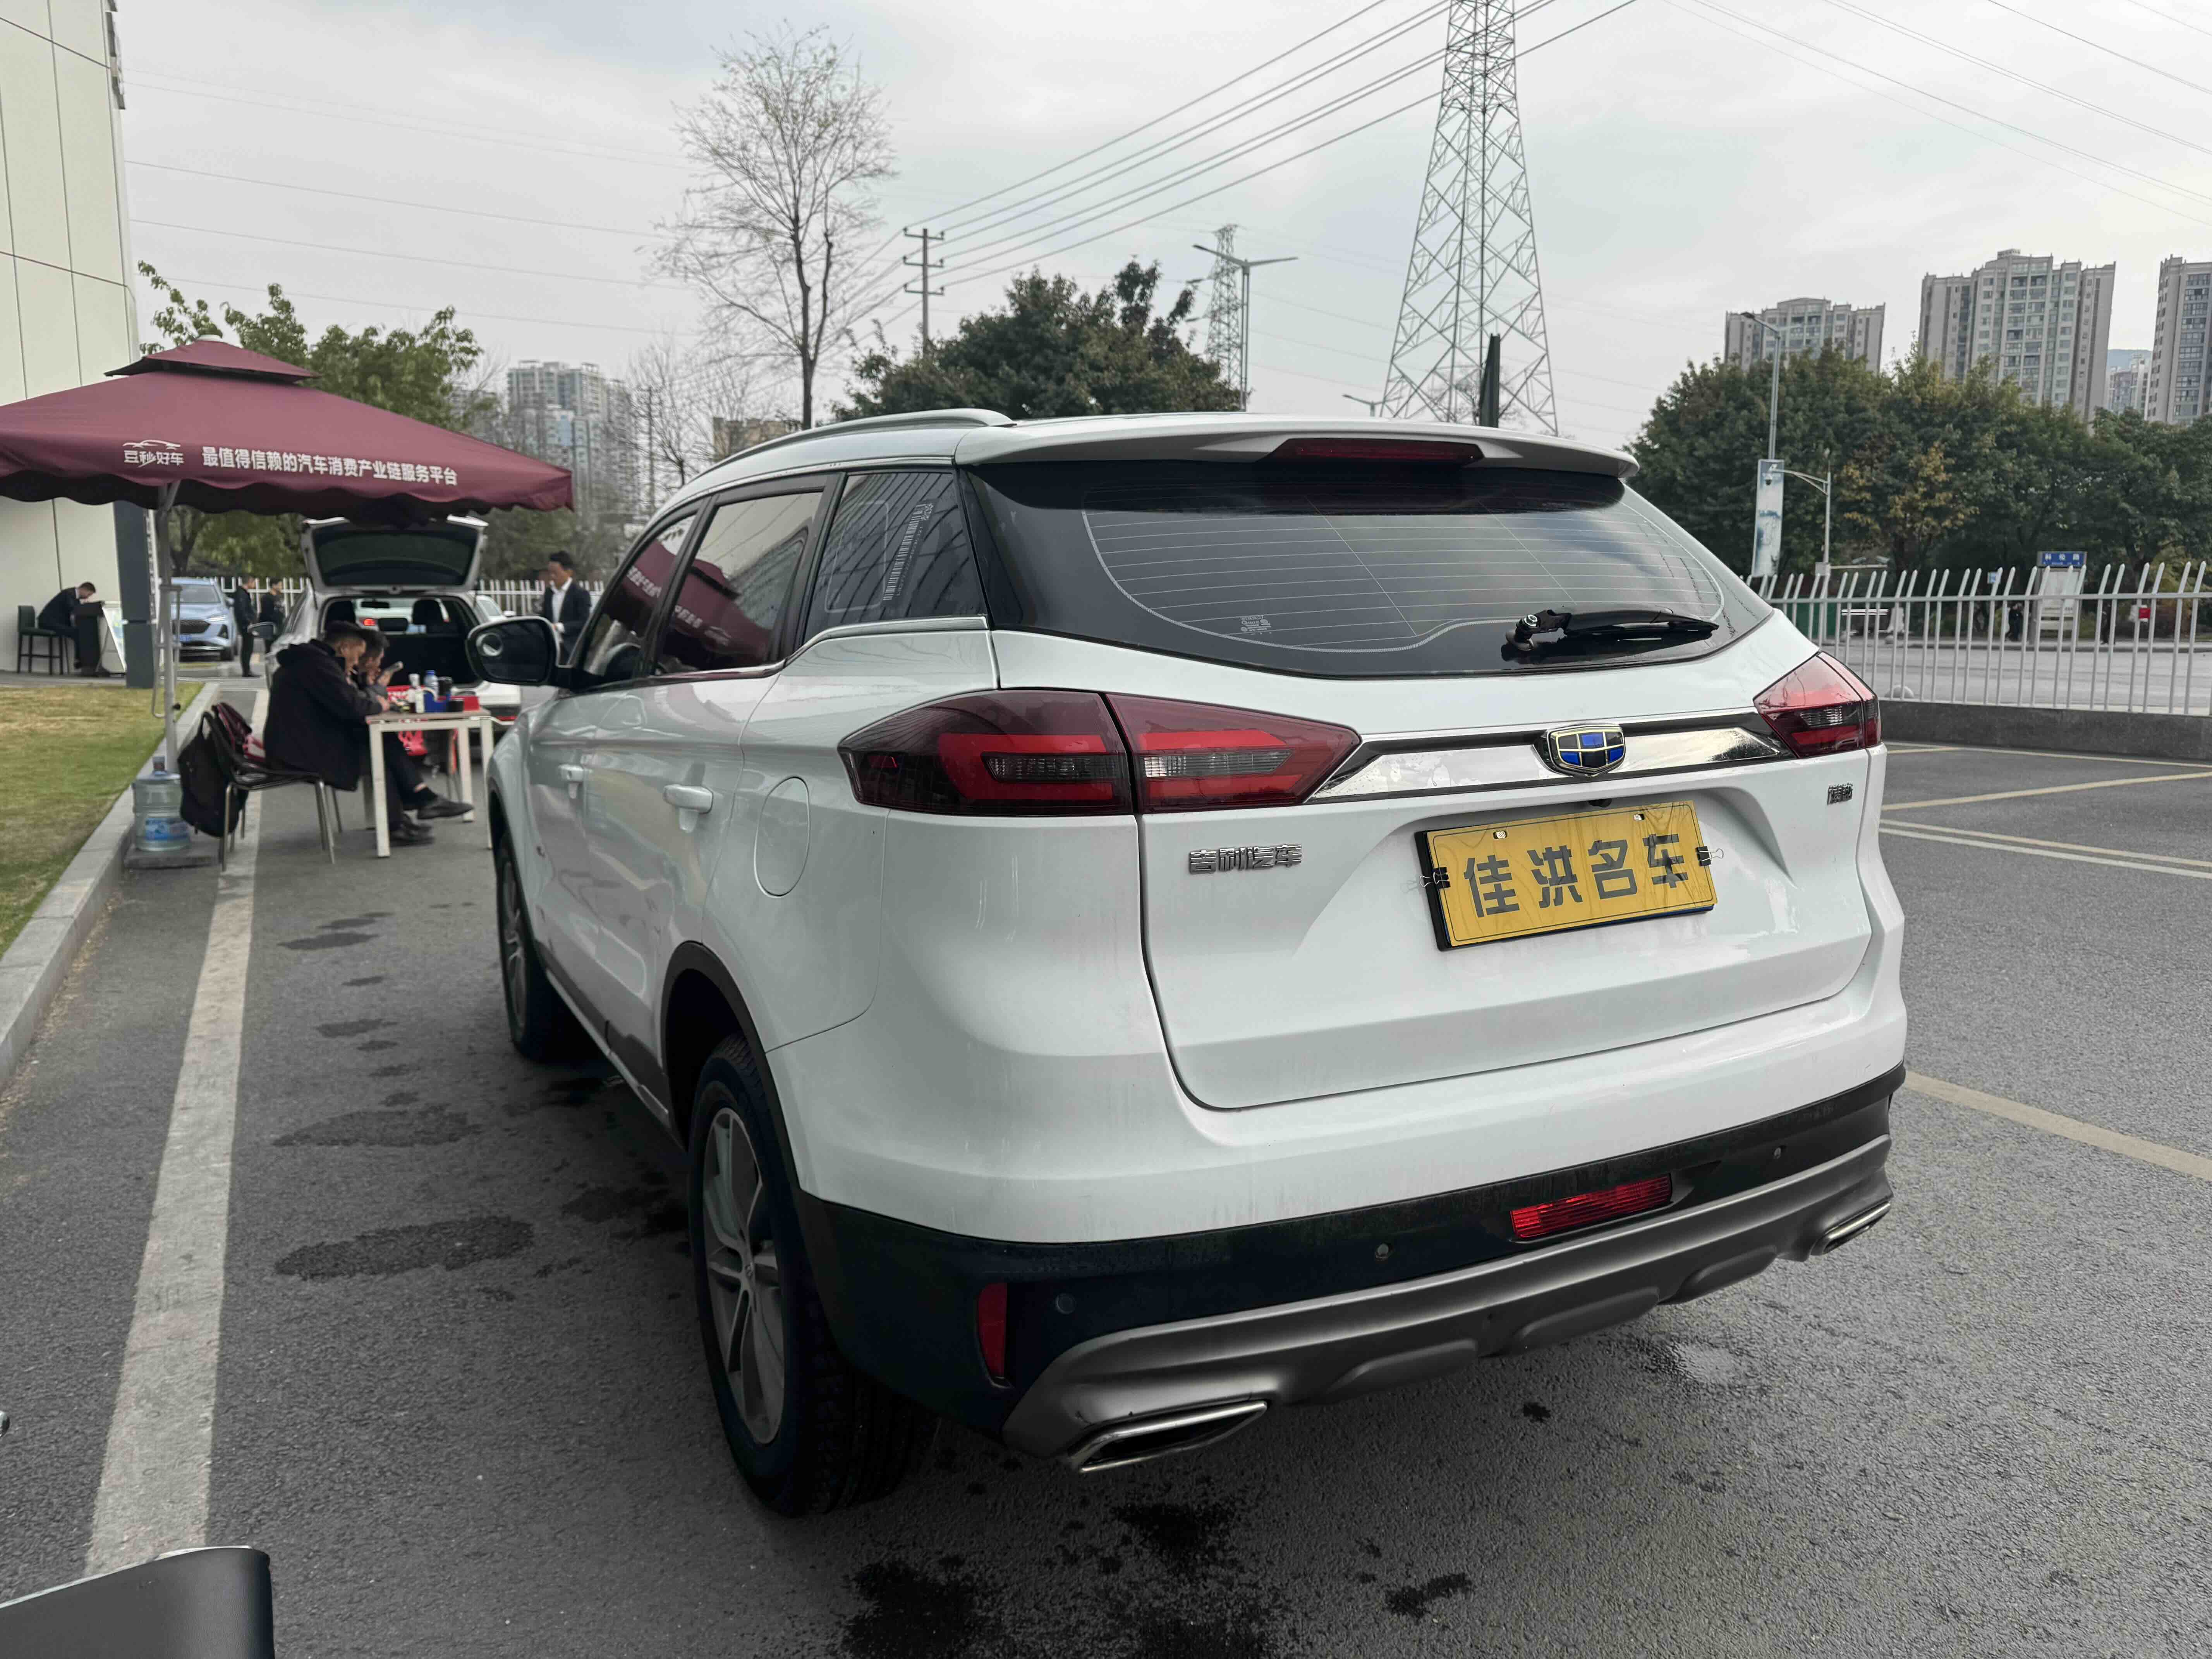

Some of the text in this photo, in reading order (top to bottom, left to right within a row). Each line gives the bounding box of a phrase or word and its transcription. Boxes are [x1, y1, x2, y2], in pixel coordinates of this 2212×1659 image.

[202, 446, 457, 486] 最值得信赖的汽车消费产业链服务平台
[1464, 833, 1689, 917] 佳洪名车
